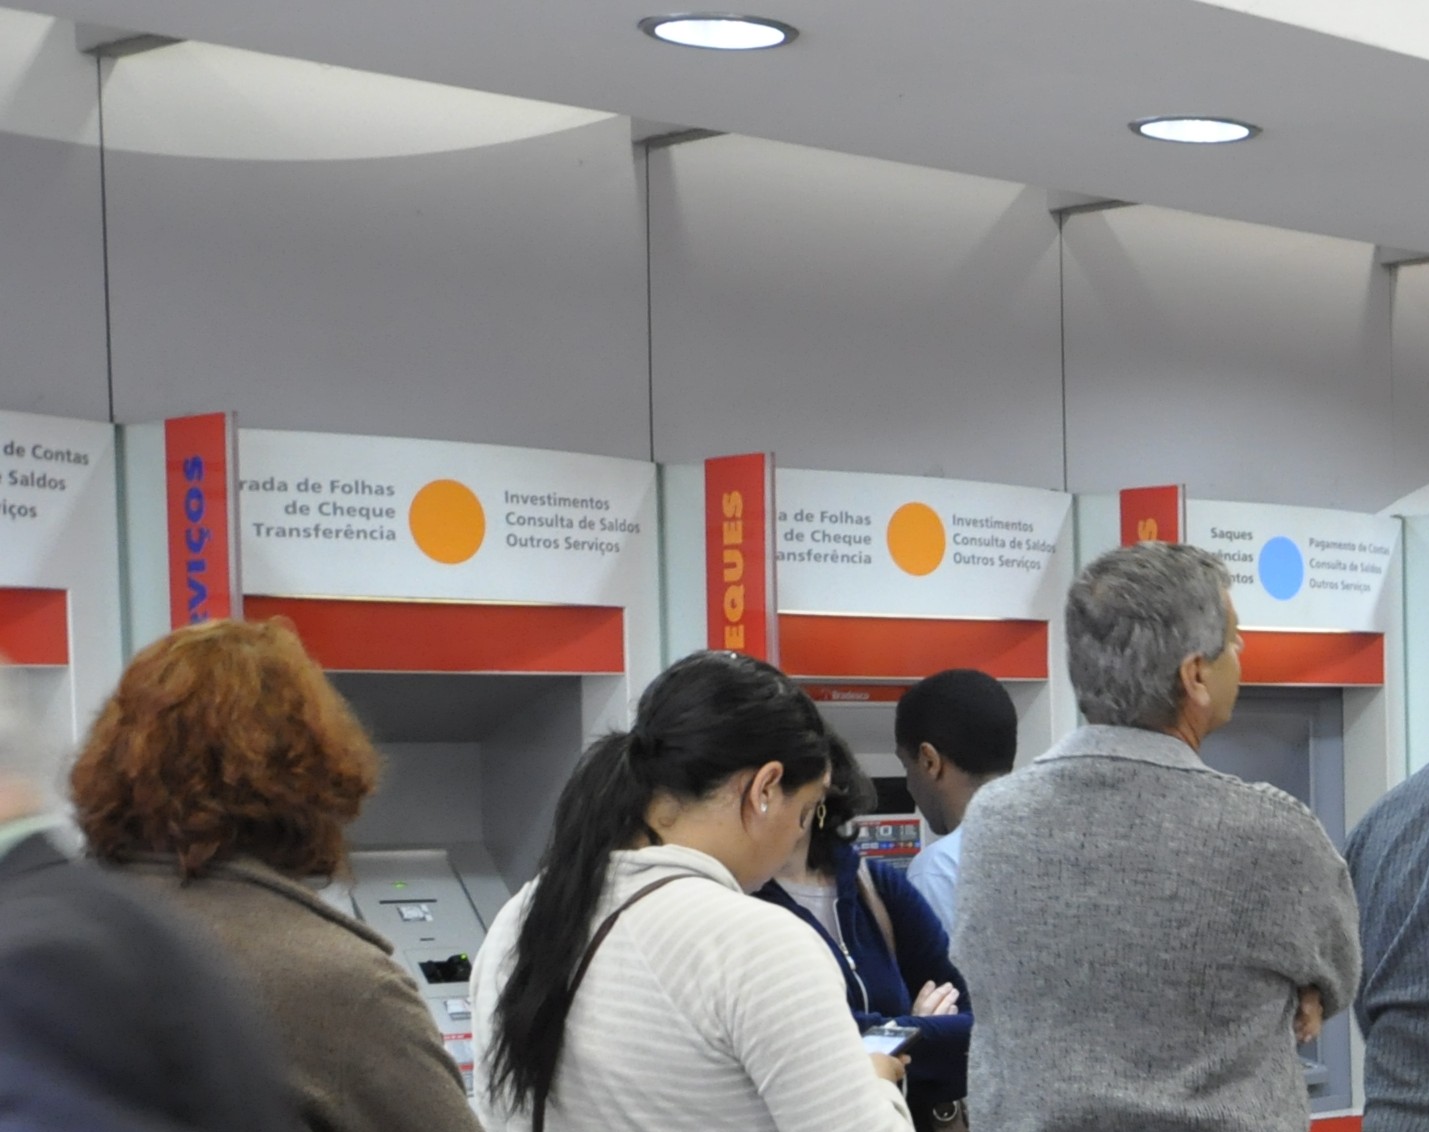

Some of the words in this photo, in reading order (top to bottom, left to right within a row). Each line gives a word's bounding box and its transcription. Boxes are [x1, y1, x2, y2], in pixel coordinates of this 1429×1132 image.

[31, 443, 90, 466] Contas
[8, 471, 67, 490] Saldos
[239, 477, 289, 493] rada
[296, 479, 322, 495] de
[329, 479, 396, 497] Folhas
[0, 496, 38, 518] iços
[504, 490, 610, 511] Investimentos
[284, 501, 311, 517] de
[318, 501, 397, 521] Cheque
[794, 509, 815, 524] de
[819, 510, 873, 527] Folhas
[252, 522, 398, 542] Transferência
[505, 511, 575, 530] Consulta
[578, 514, 596, 531] de
[599, 515, 641, 535] Saldos
[952, 513, 1035, 533] Investimentos
[783, 528, 805, 543] de
[810, 528, 872, 546] Cheque
[952, 532, 1006, 550] Consulta
[1008, 535, 1024, 551] de
[1025, 538, 1057, 555] Saldos
[1210, 526, 1254, 542] Saques
[506, 533, 560, 550] Outros
[564, 535, 621, 557] Serviços
[775, 548, 873, 565] ansferência
[952, 551, 996, 568] Outros
[998, 554, 1042, 573] Serviços
[1308, 557, 1347, 571] Consulta
[722, 490, 745, 649] EQUES
